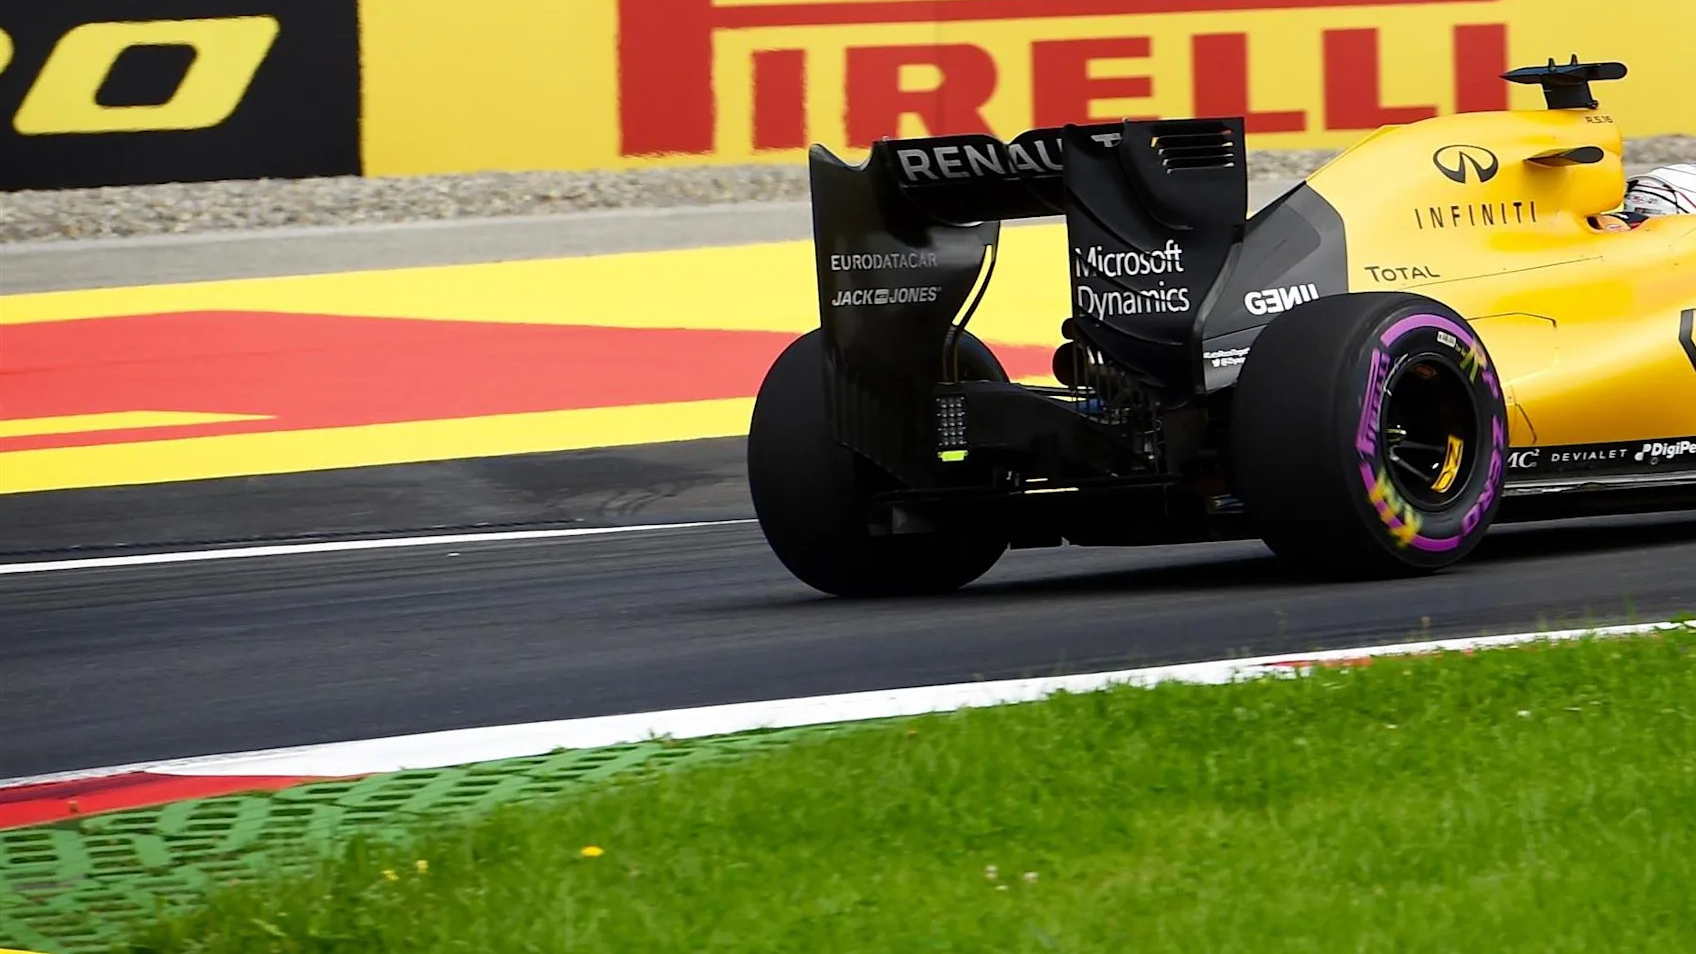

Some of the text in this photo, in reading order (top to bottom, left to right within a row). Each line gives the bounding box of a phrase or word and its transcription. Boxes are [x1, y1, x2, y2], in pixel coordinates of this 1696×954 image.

[897, 132, 1122, 182] RENAUT
[1414, 201, 1537, 229] INFINITI
[830, 252, 938, 271] EURODATACAR
[1075, 239, 1184, 277] Microsoft
[1077, 281, 1190, 321] Dynamics
[1551, 449, 1628, 462] DEVIALET
